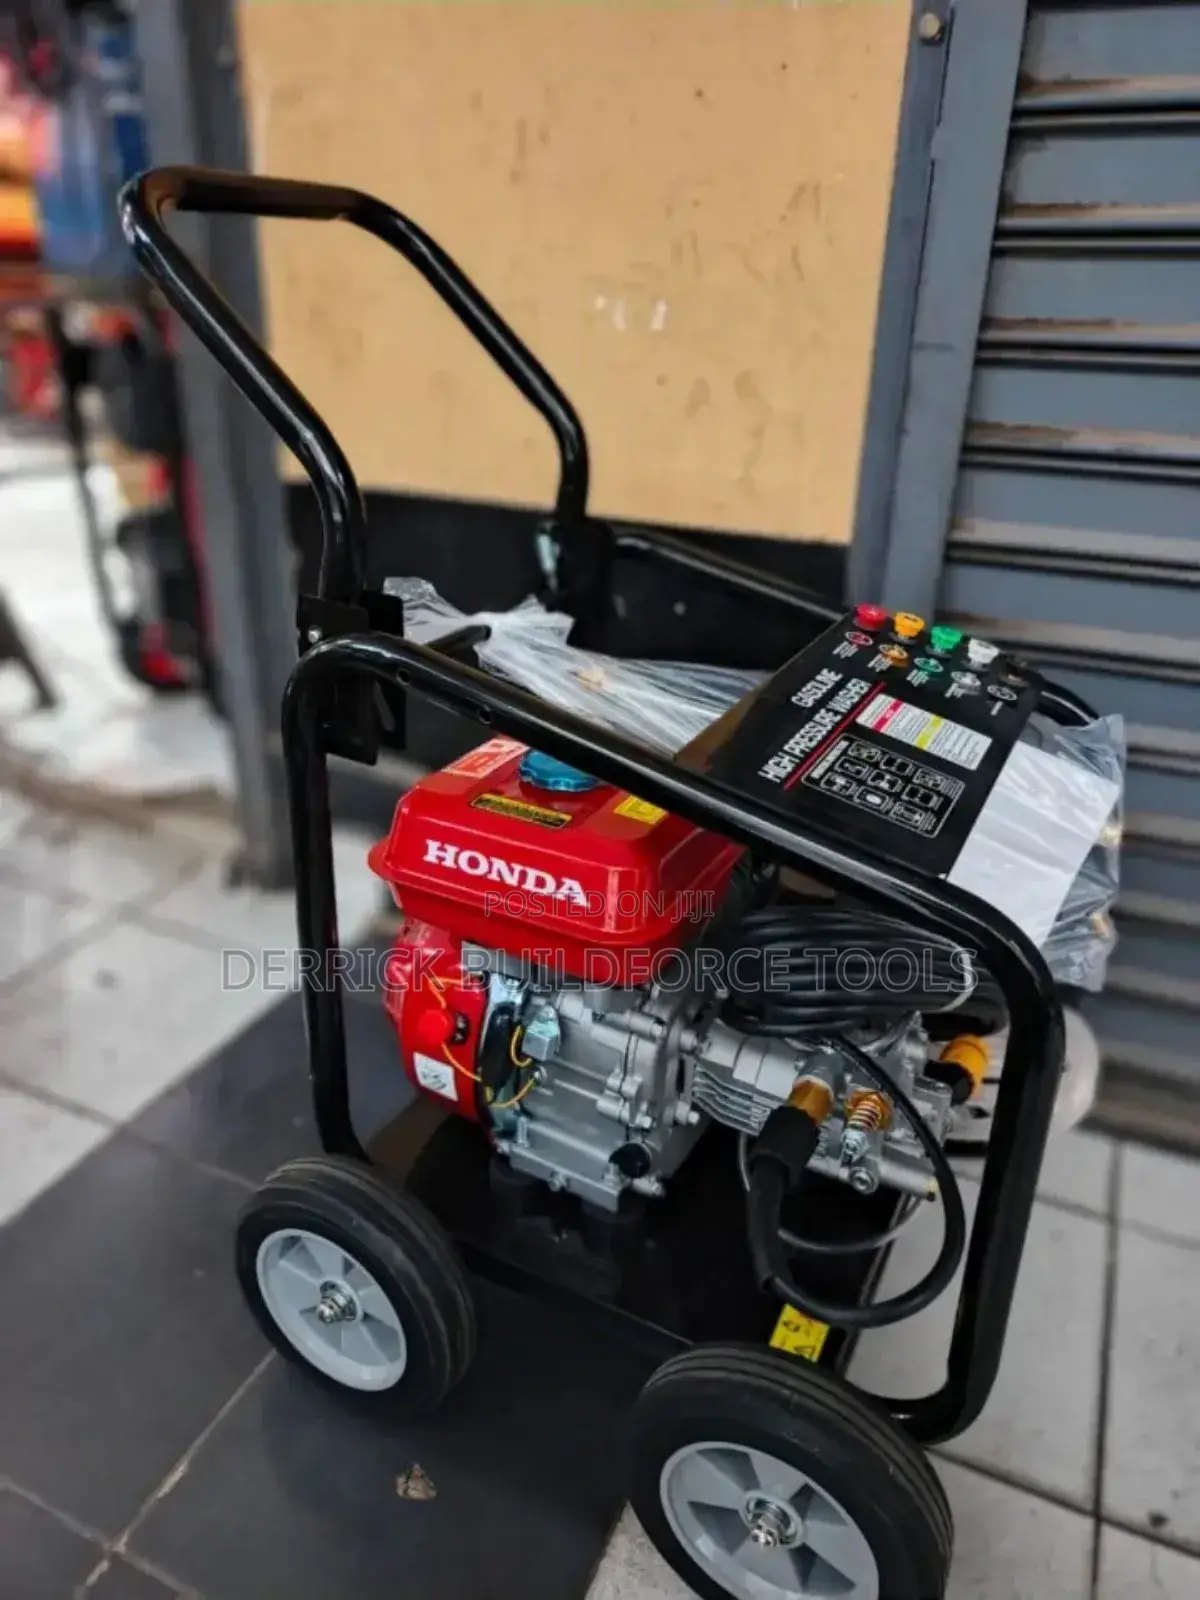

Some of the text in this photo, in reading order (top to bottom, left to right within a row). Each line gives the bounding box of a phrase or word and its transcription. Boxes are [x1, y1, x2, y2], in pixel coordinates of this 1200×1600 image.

[791, 668, 843, 708] GASOLINE
[758, 751, 800, 783] HIGH
[783, 708, 842, 758] PRESSURE
[826, 678, 872, 713] WASHER
[423, 839, 591, 907] HONDA
